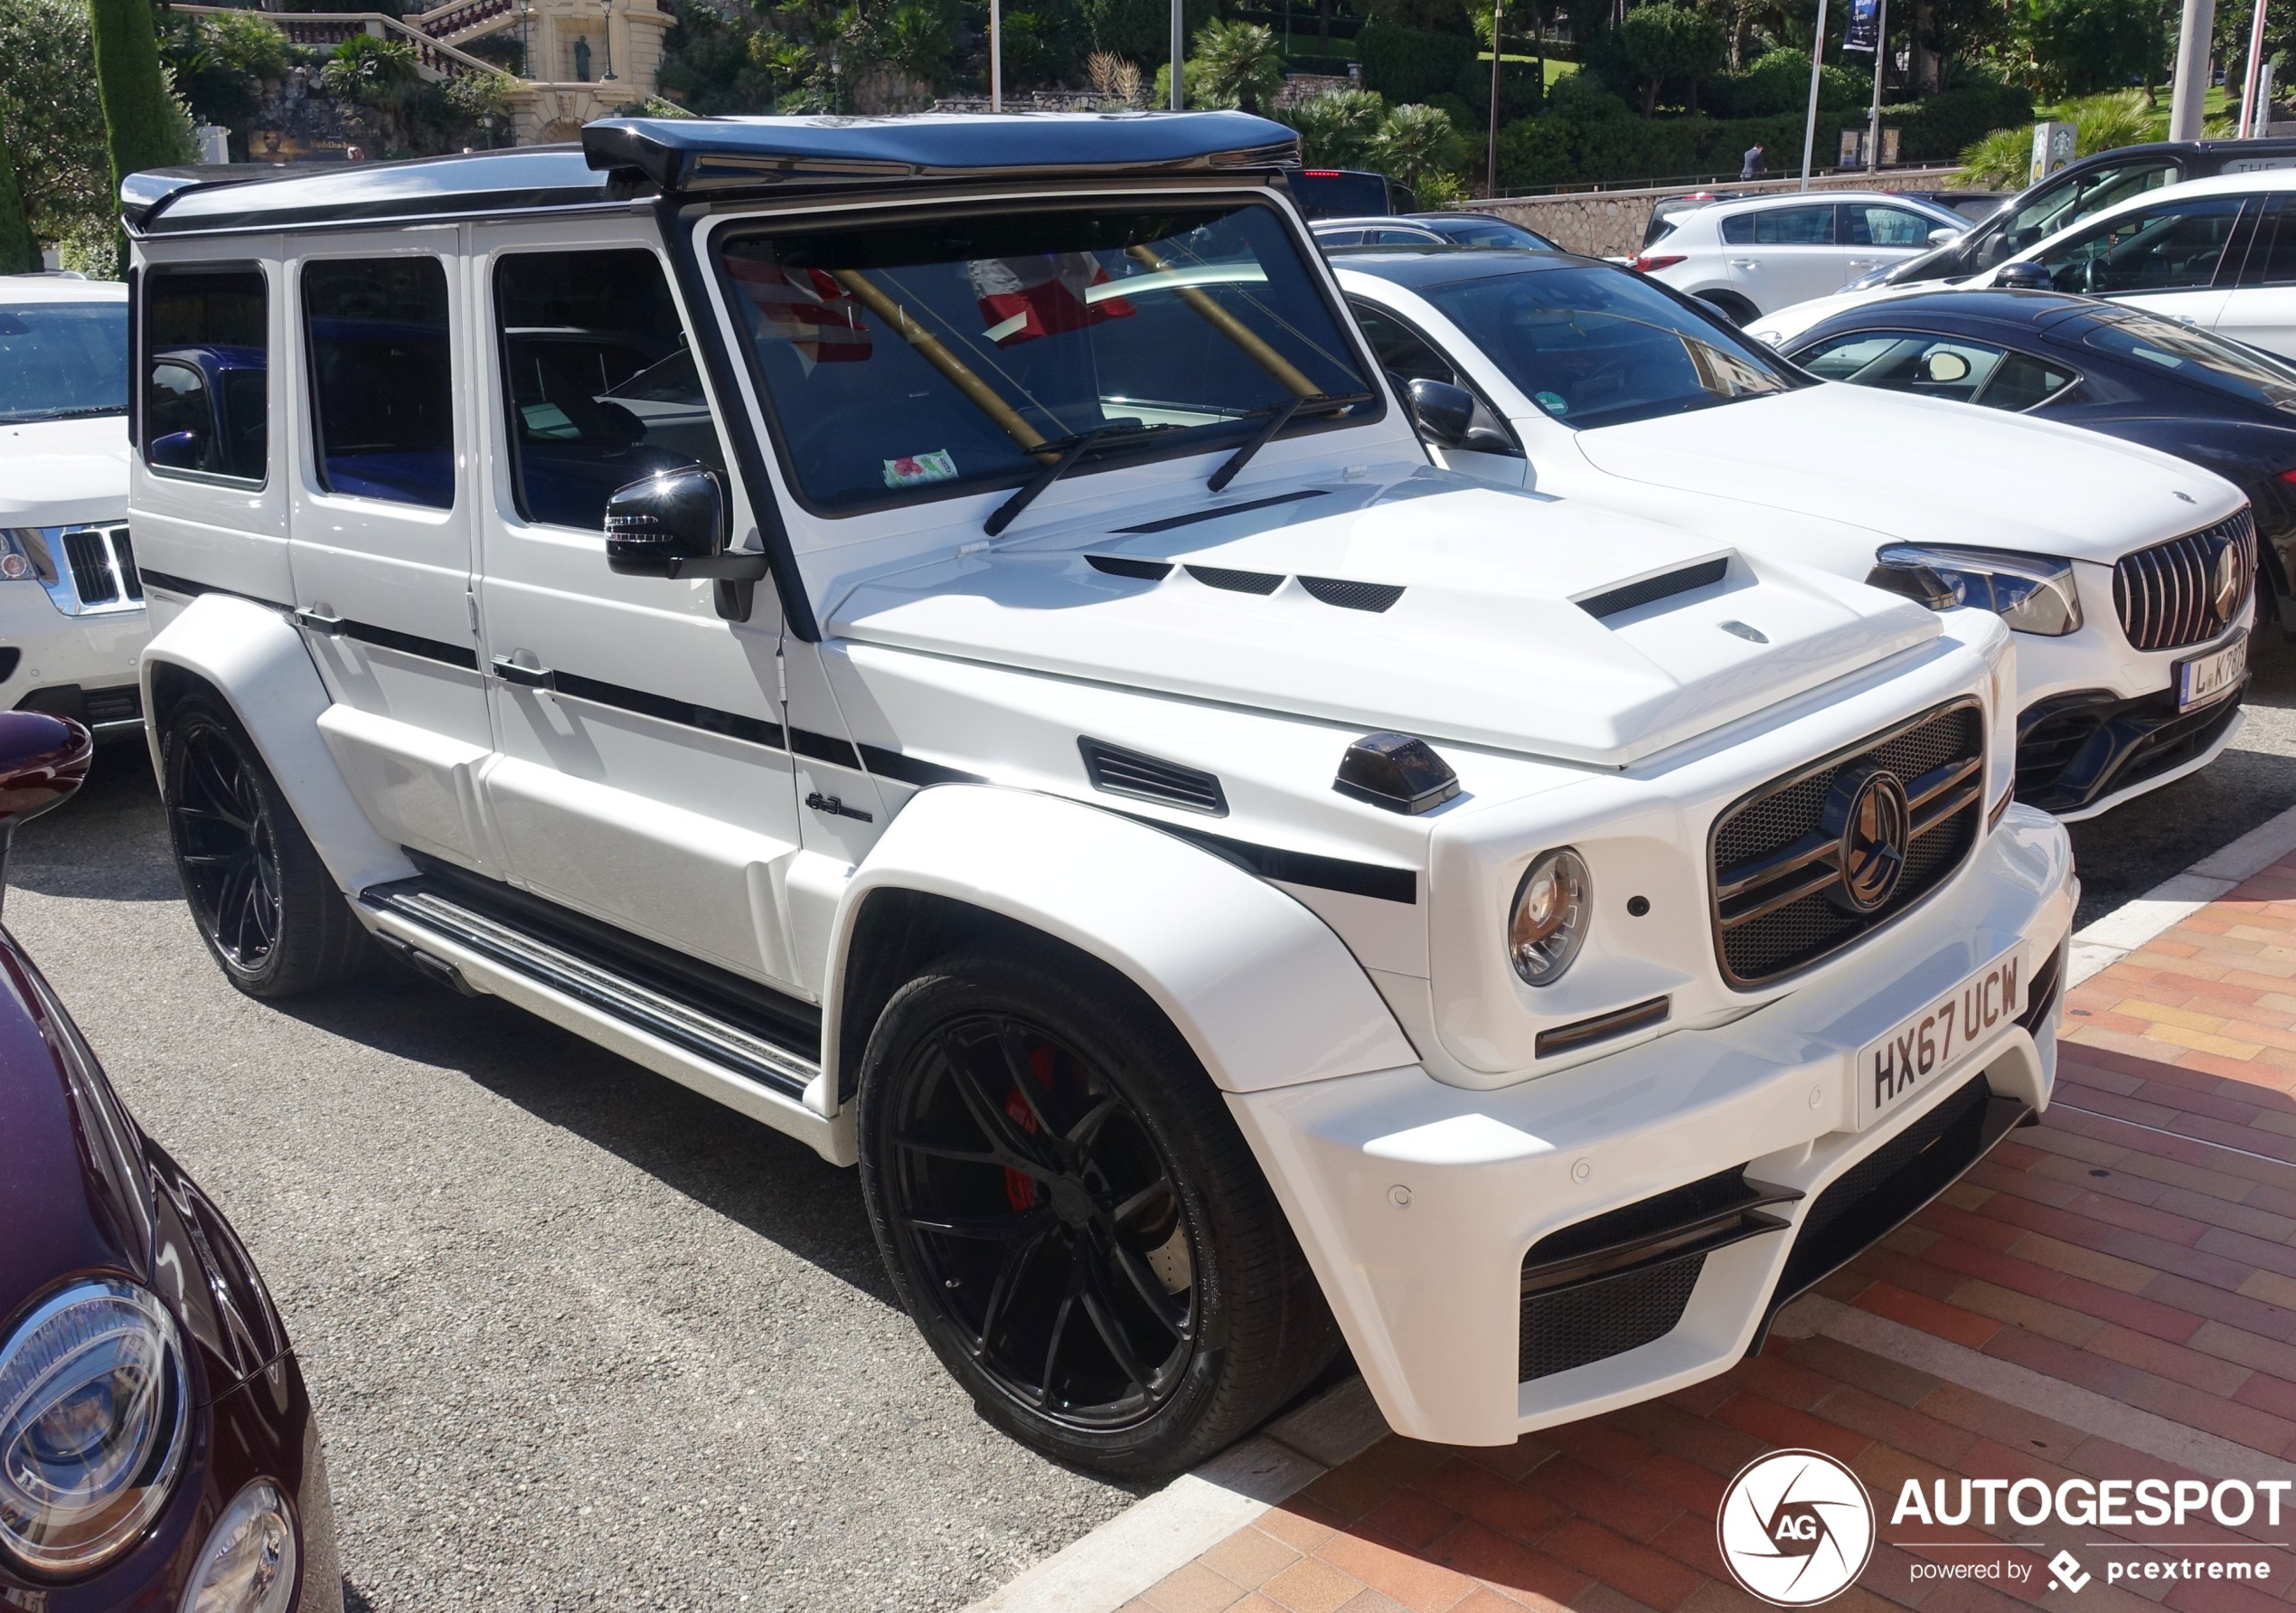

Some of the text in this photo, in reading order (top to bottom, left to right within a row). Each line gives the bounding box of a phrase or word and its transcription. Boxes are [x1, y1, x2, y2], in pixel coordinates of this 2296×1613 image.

[2196, 663, 2206, 695] L
[2215, 654, 2225, 687] K
[1875, 956, 2018, 1109] HX67 UCW
